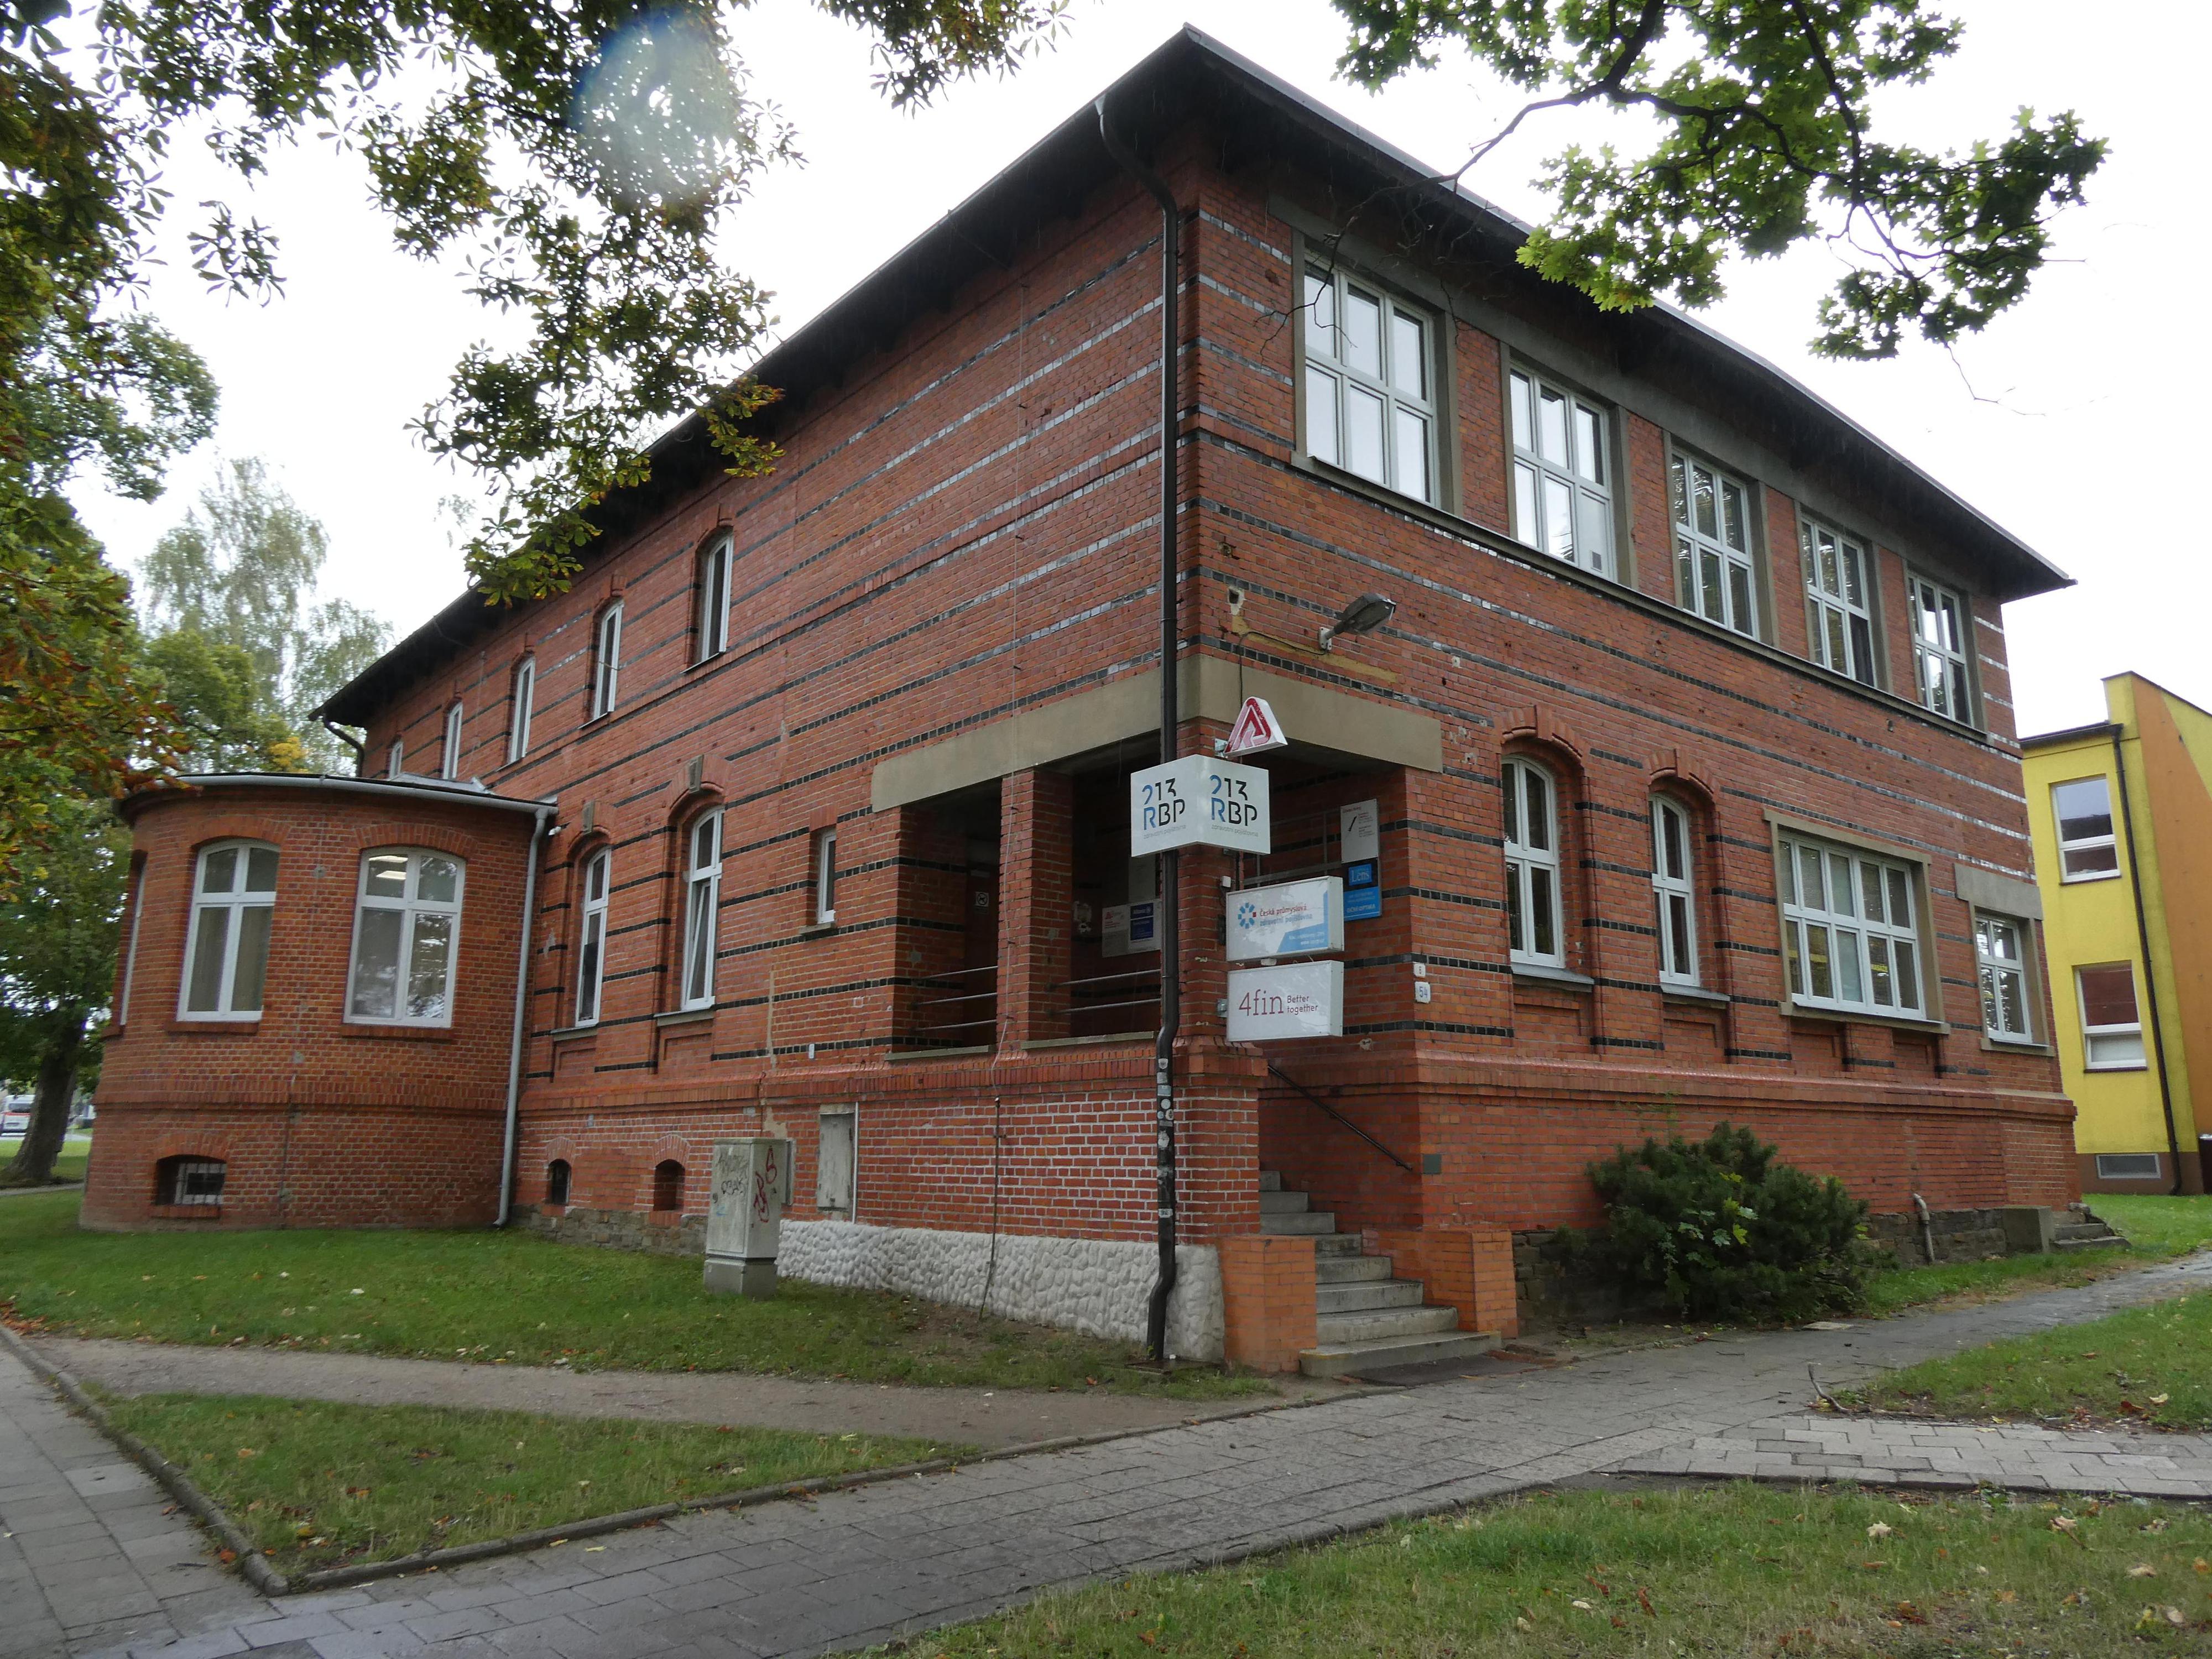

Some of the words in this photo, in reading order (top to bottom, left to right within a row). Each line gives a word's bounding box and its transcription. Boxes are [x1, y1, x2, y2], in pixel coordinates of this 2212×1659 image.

[1141, 778, 1177, 805] 213
[1209, 774, 1248, 801] 213
[1143, 799, 1186, 831] RBP
[1211, 797, 1258, 827] RBP
[1260, 908, 1275, 917] Česká
[1239, 989, 1284, 1016] 4fin
[1287, 995, 1310, 1003] Better
[1419, 986, 1428, 998] 54
[1287, 1004, 1318, 1015] together
